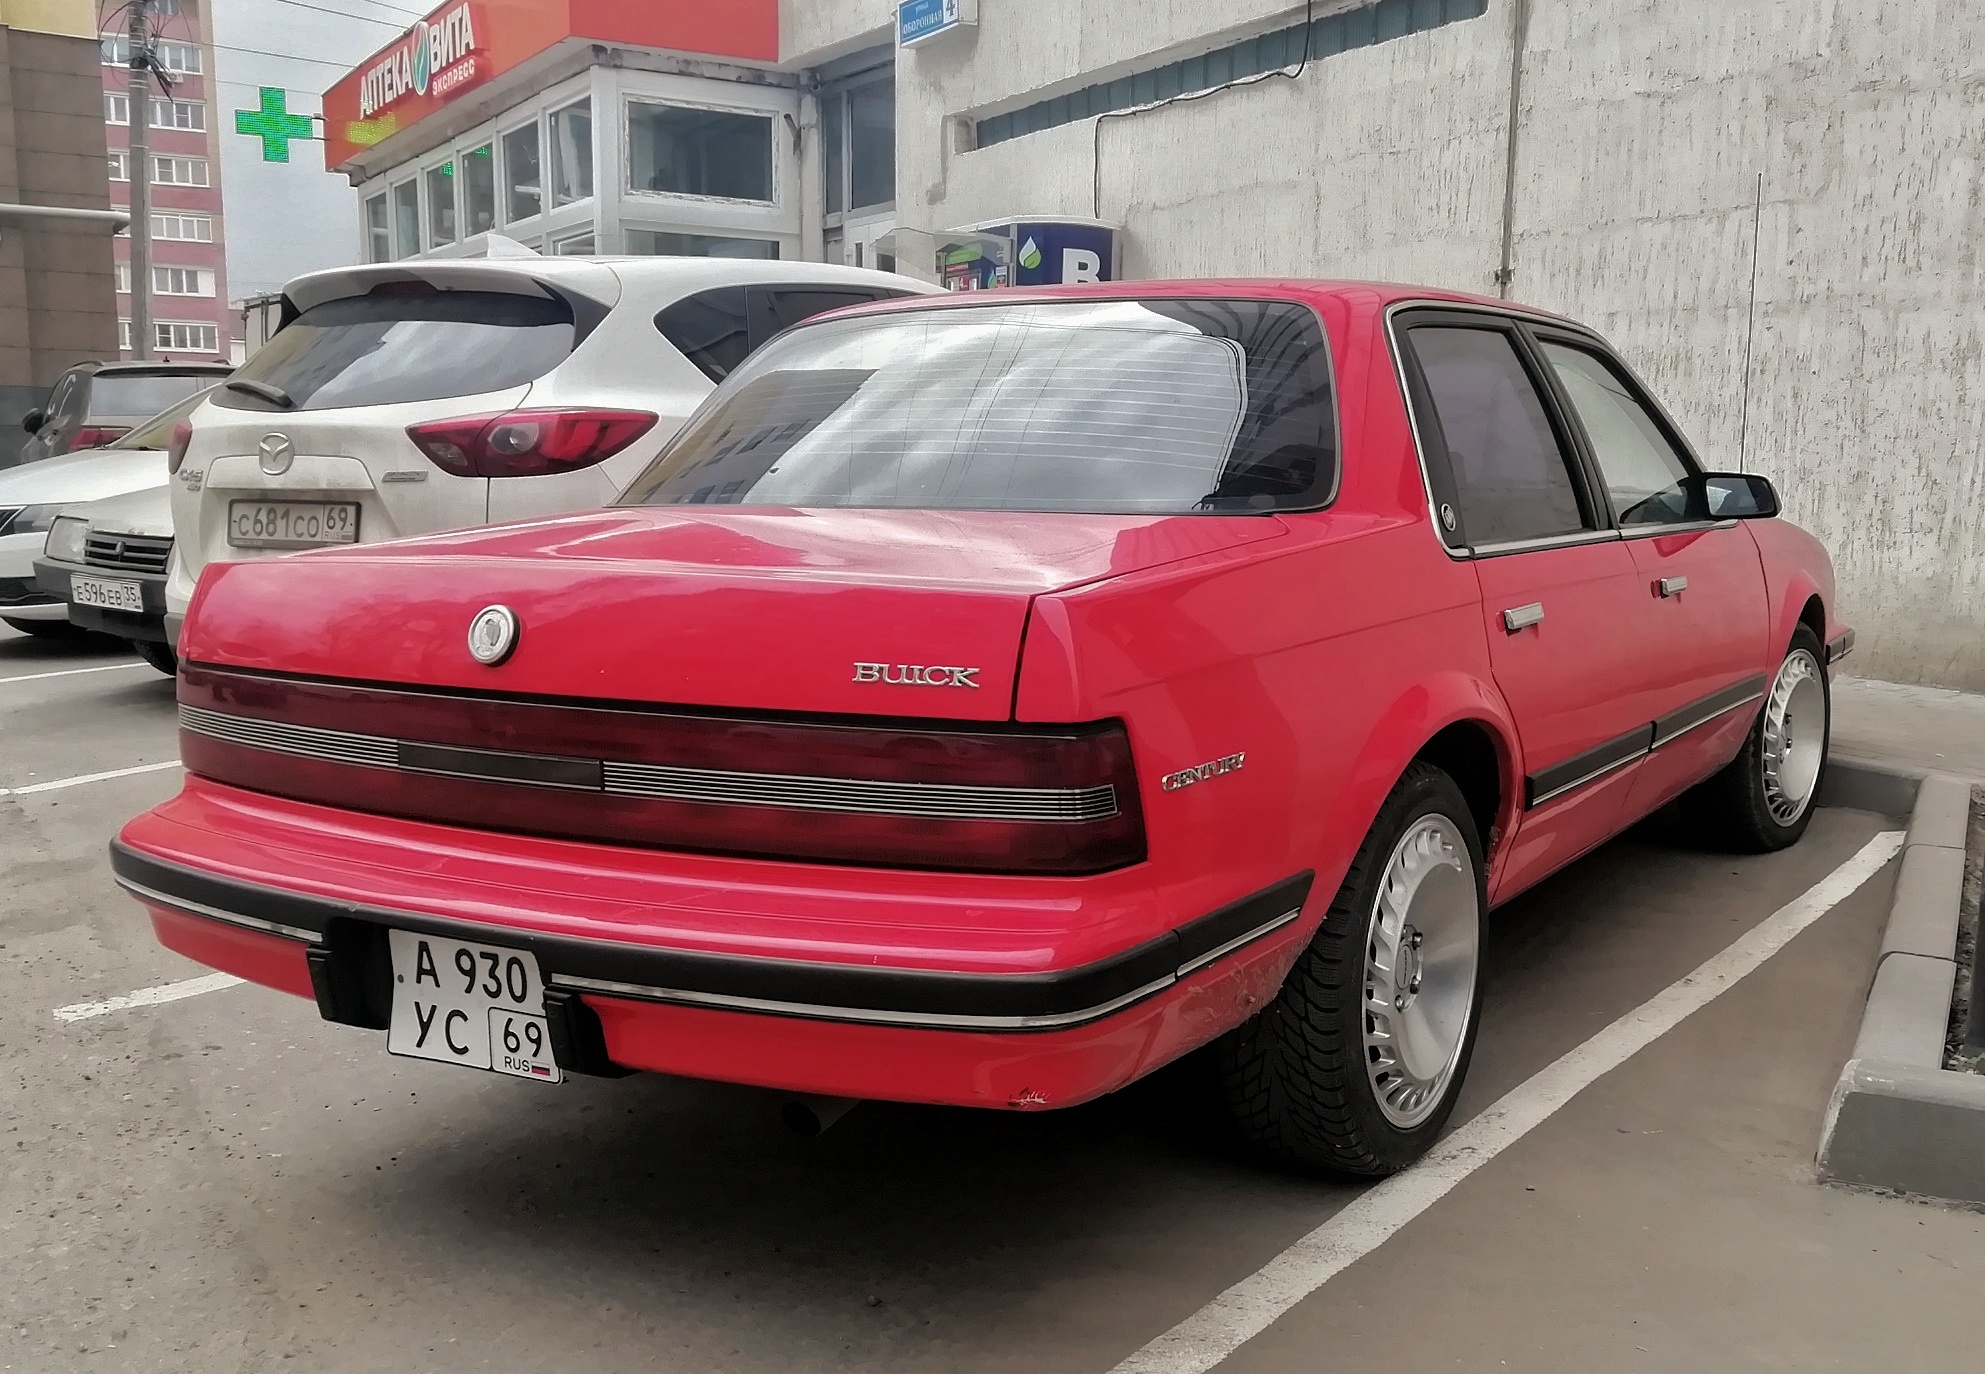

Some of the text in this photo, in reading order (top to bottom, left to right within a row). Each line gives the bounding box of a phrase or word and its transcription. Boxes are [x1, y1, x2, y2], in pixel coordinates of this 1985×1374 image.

[903, 10, 942, 35] ОБОРОННАЯ
[946, 0, 956, 17] 4
[360, 2, 475, 120] АПТЕКА ВИТА
[432, 58, 475, 96] ЭКСПРЕСС
[238, 507, 348, 538] С681СО 69
[76, 582, 137, 605] Е596ЕВ 35
[851, 661, 980, 688] BUICK
[1161, 751, 1245, 792] CENTURY
[503, 1017, 542, 1058] 69
[504, 1055, 530, 1072] RUS
